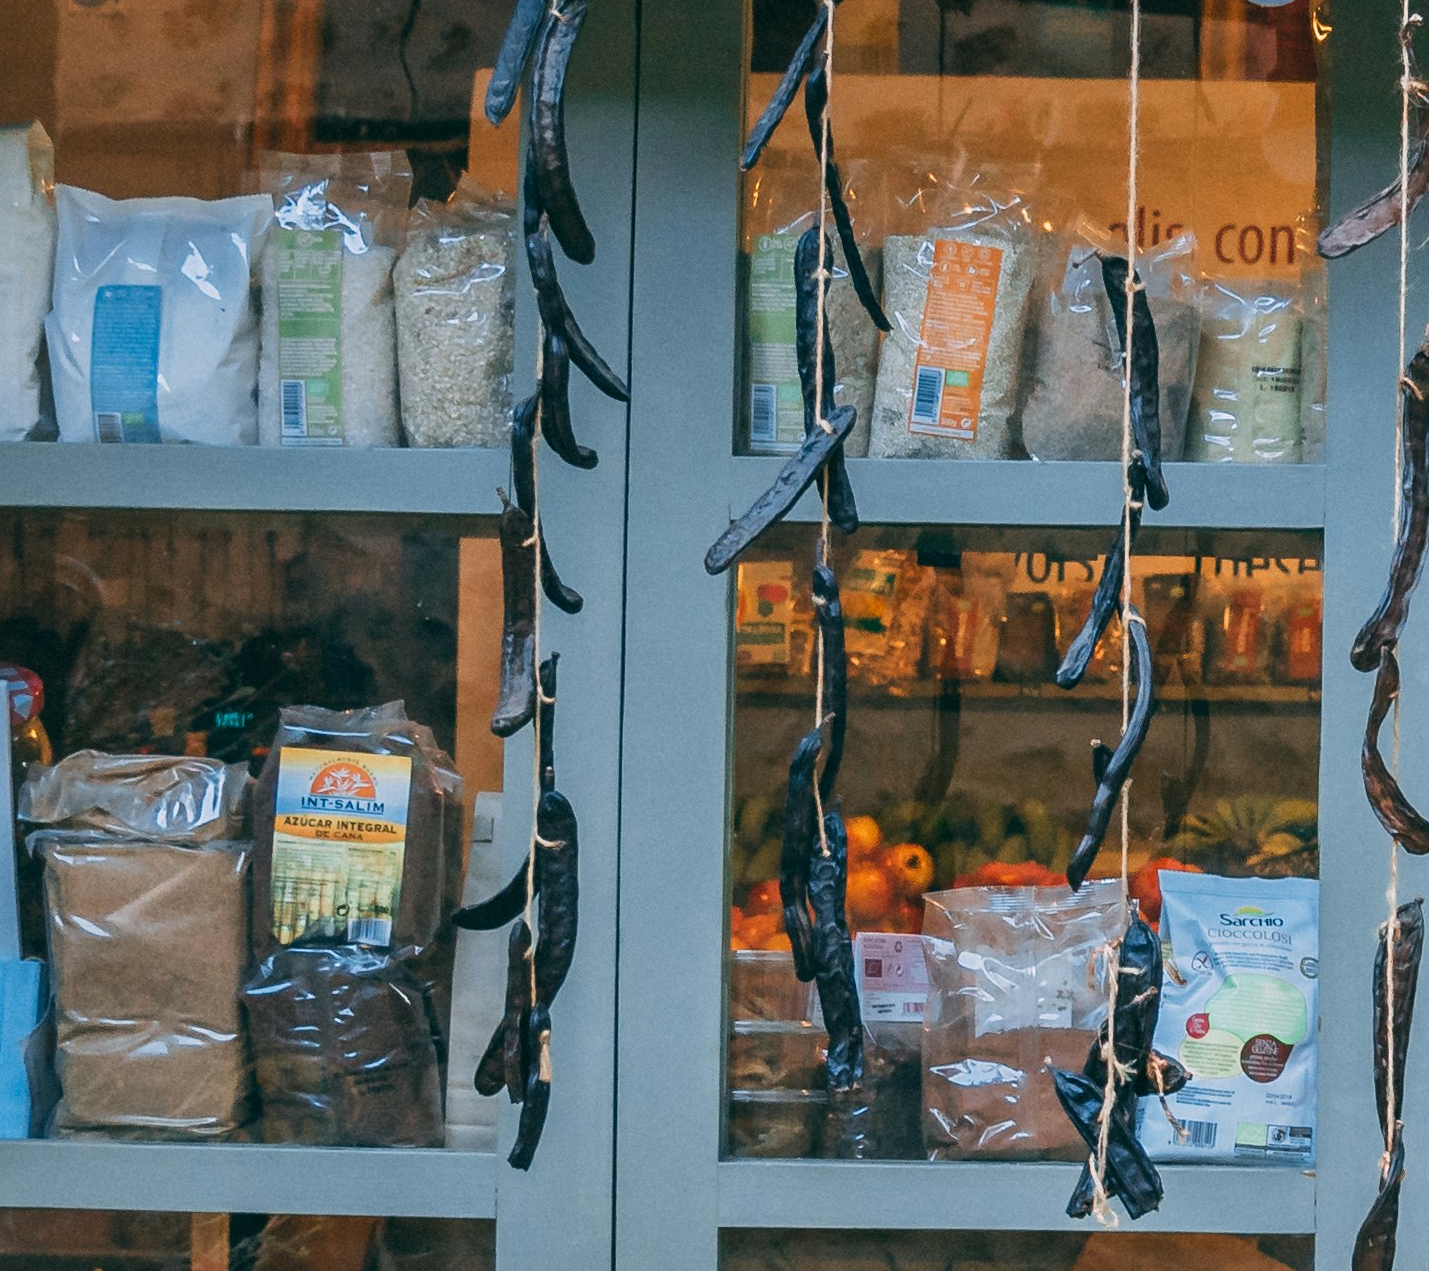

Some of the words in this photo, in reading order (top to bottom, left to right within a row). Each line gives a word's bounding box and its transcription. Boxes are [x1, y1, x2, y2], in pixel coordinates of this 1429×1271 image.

[1214, 223, 1295, 265] con
[301, 796, 385, 813] INT-SALIM
[283, 815, 332, 829] AZÚCAR
[336, 820, 398, 834] INTEGRAL
[315, 830, 330, 839] DE
[1207, 928, 1293, 945] CIOCCOLOSI
